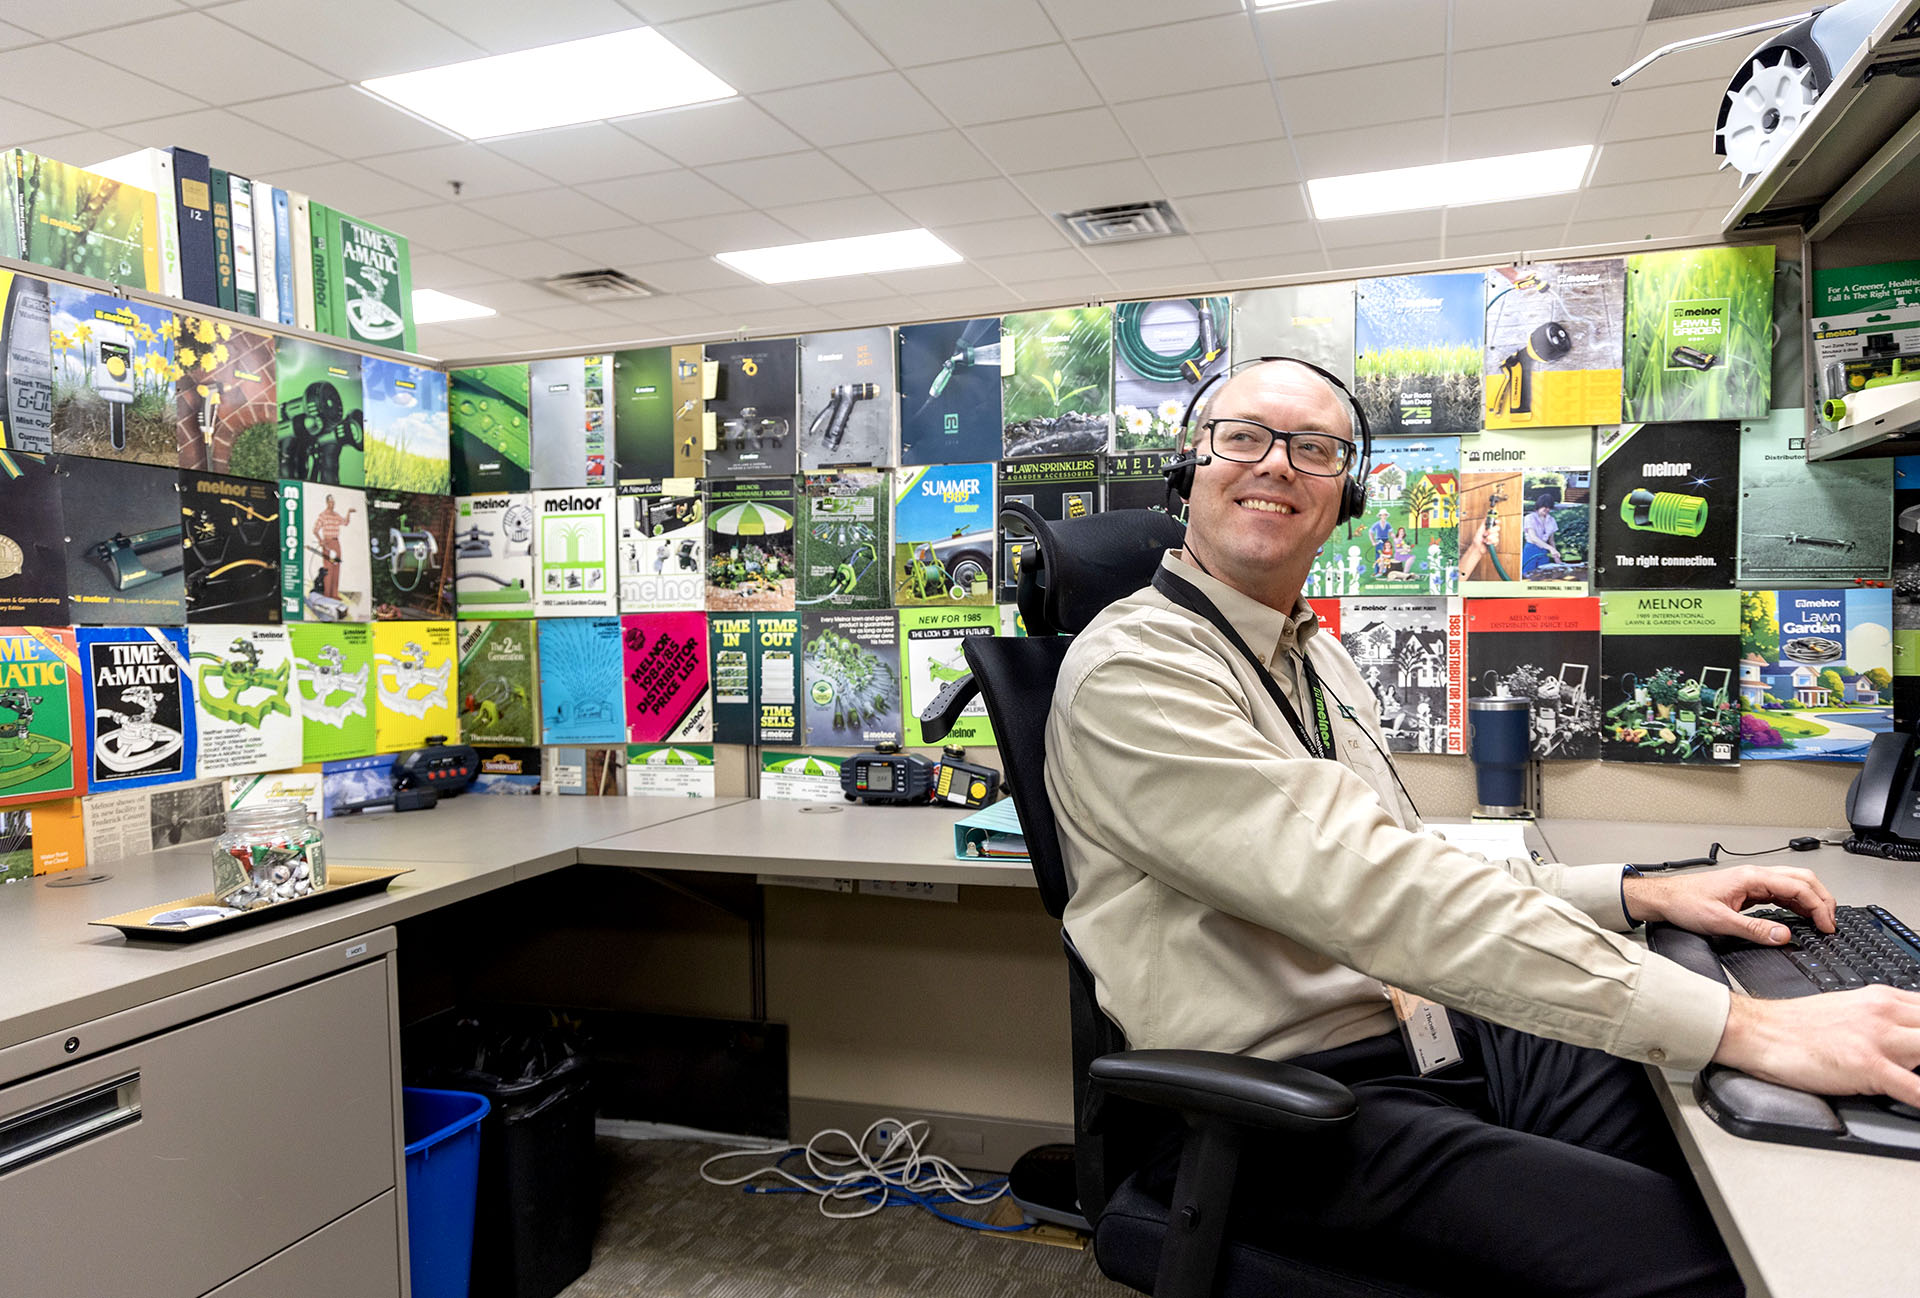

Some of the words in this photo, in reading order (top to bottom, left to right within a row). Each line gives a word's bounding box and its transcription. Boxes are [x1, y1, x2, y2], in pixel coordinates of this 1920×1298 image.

[190, 209, 203, 221] 12
[314, 254, 327, 309] melnor
[1828, 287, 1841, 295] For
[1852, 283, 1886, 292] Greener,
[1828, 294, 1842, 302] Fall
[1853, 291, 1868, 300] The
[1869, 290, 1890, 300] Right
[1892, 288, 1912, 296] Time
[1685, 308, 1722, 316] melnor
[1673, 319, 1709, 328] LAWN
[1673, 327, 1721, 336] GARDEN
[1825, 330, 1858, 338] melnor
[13, 377, 34, 389] Start
[1401, 407, 1432, 419] 75
[16, 416, 33, 426] Mist
[18, 432, 49, 444] Current
[1483, 449, 1526, 462] melnor
[1013, 463, 1039, 474] LAWN
[1040, 460, 1095, 473] SPRINKLERS
[1642, 461, 1692, 478] melnor
[1013, 473, 1045, 481] GARDEN
[1047, 471, 1095, 479] ACCESSORIES
[197, 480, 248, 497] melnor
[630, 485, 645, 493] New
[922, 478, 980, 497] SUMMER
[473, 497, 510, 510] melnor
[943, 491, 969, 503] 1989
[544, 496, 602, 513] melnor
[284, 486, 300, 560] melnor
[1616, 555, 1634, 566] The
[1636, 554, 1659, 568] right
[1661, 554, 1717, 567] connection.
[39, 597, 60, 606] Catalog
[1638, 598, 1703, 610] MELNOR
[1806, 599, 1840, 608] melnor
[919, 616, 938, 624] NEW
[942, 615, 960, 623] FOR
[963, 614, 981, 622] 1985
[1802, 611, 1841, 623] Lawn
[713, 619, 750, 633] TIME
[757, 619, 797, 633] TIME
[839, 621, 859, 629] product
[1449, 615, 1461, 638] 1988
[1783, 622, 1841, 634] Garden
[491, 642, 503, 651] The
[723, 633, 740, 647] IN
[761, 633, 795, 647] OUT
[109, 645, 165, 666] TIME-
[631, 633, 671, 685] MELNOR
[639, 640, 680, 691] 1984/85
[1449, 640, 1461, 700] DISTRIBUTOR
[0, 661, 65, 689] ATIC
[97, 664, 177, 687] A-MATIC
[637, 637, 699, 714] DISTRIBUTOR
[651, 679, 681, 716] PRICE
[677, 653, 699, 682] LIST
[761, 706, 793, 717] TIME
[1449, 703, 1461, 731] PRICE
[682, 706, 706, 736] melnor
[761, 716, 795, 728] SELLS
[1316, 699, 1331, 749] melnor
[1449, 733, 1461, 752] LIST
[90, 801, 116, 811] Melnor
[101, 810, 113, 818] new
[114, 806, 136, 816] facility
[91, 816, 121, 827] Frederick
